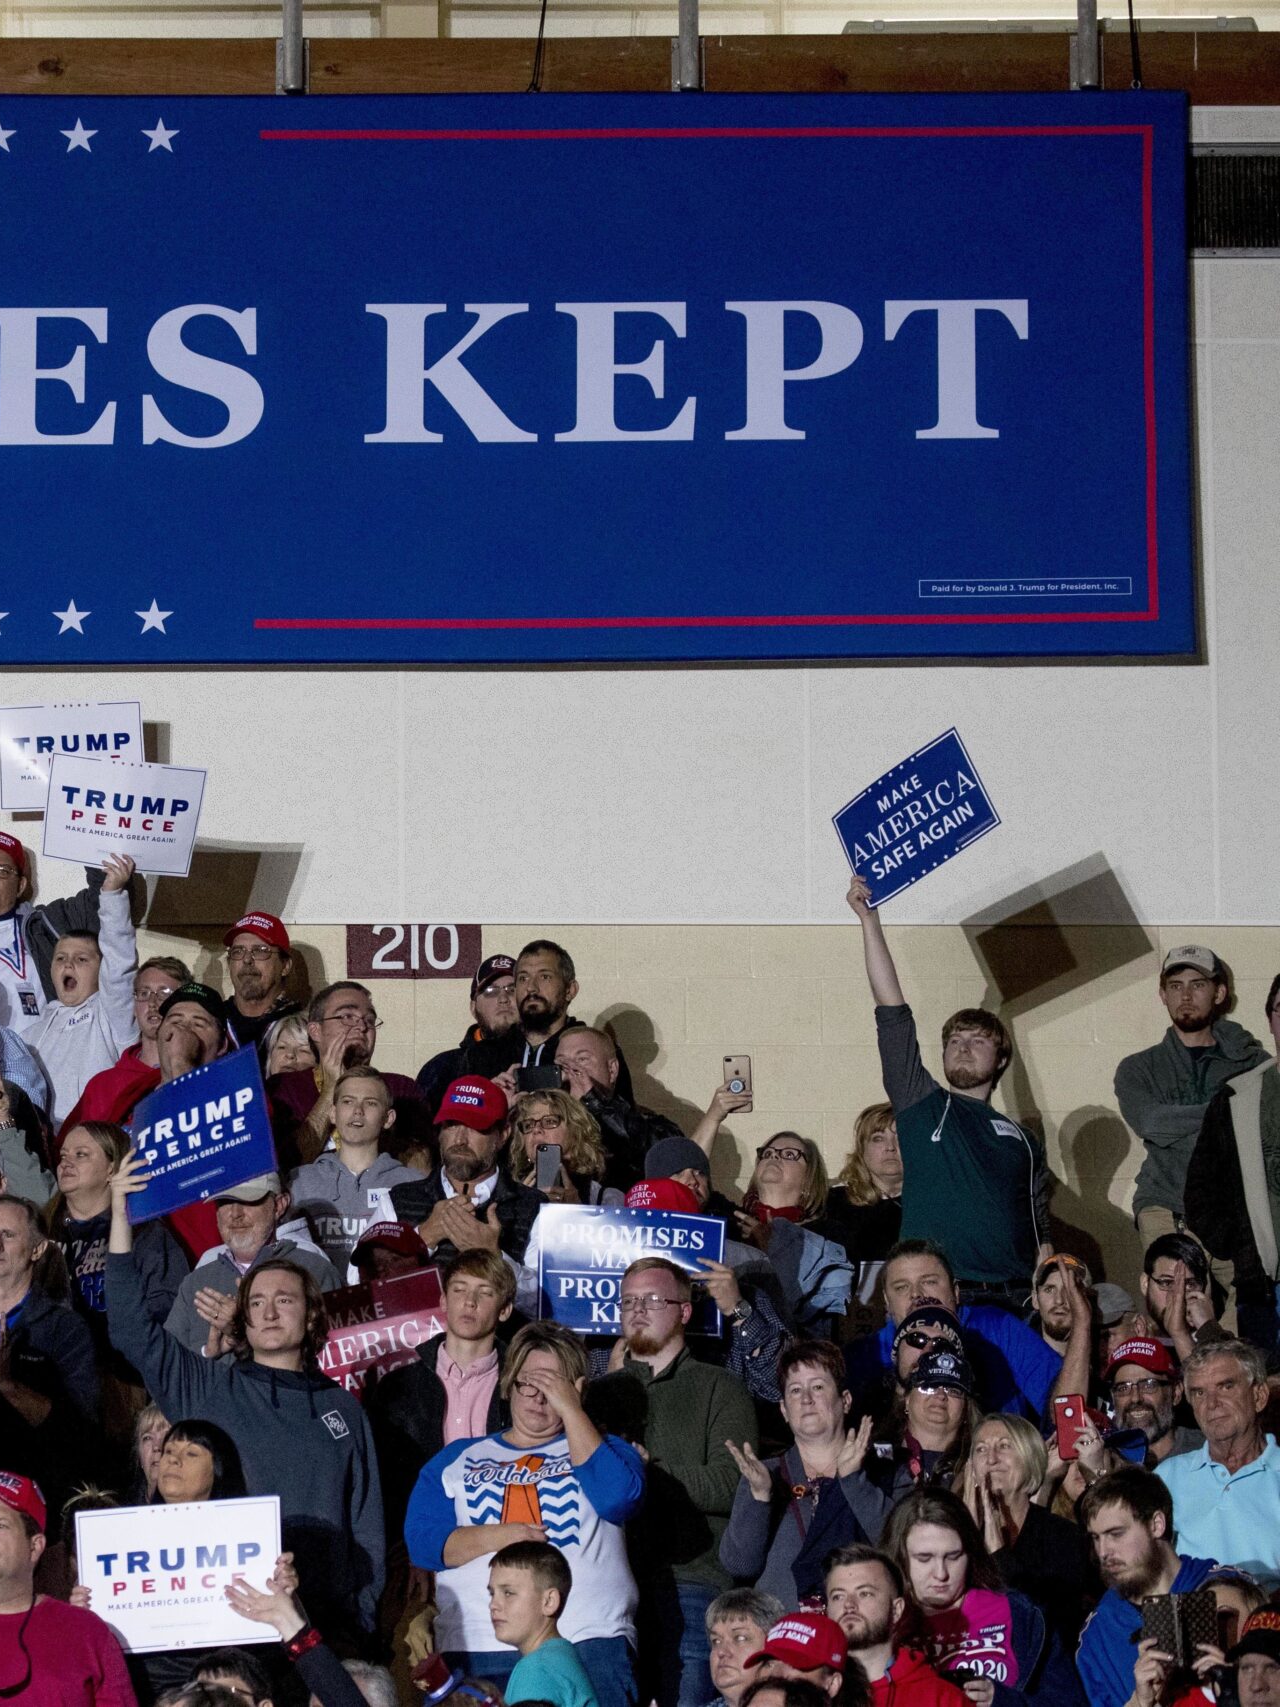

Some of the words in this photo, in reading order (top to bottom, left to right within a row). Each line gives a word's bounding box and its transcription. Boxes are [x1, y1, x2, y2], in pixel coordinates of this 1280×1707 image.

[364, 299, 1029, 443] KEPT
[952, 584, 964, 592] for
[965, 585, 976, 593] by
[977, 584, 1007, 592] Donald
[1017, 584, 1045, 592] Trump
[1047, 583, 1059, 591] for
[61, 785, 189, 817] TRUMP
[876, 774, 922, 813] MAKE
[71, 809, 175, 833] PENCE
[853, 770, 976, 868] AMERICA
[65, 824, 87, 834] MAKE
[89, 830, 124, 840] AMERICA
[126, 834, 149, 842] GREAT
[151, 836, 177, 844] AGAIN!
[871, 839, 917, 880] SAFE
[918, 801, 974, 850] AGAIN
[372, 924, 459, 970] 210
[454, 1095, 479, 1106] 2020
[455, 1085, 486, 1095] TRUMP
[137, 1087, 253, 1150] TRUMP
[145, 1117, 246, 1166] PENCE
[166, 1154, 199, 1172] AMERICA
[199, 1145, 224, 1159] GREAT
[224, 1133, 252, 1150] AGAIN!
[200, 1189, 210, 1199] 45
[562, 1223, 705, 1250] PROMISES
[327, 1301, 387, 1331] MAKE
[316, 1314, 444, 1371] MERICA
[1127, 1341, 1157, 1352] AMERICA
[1131, 1347, 1154, 1357] AGAIN
[96, 1541, 261, 1577] TRUMP
[107, 1603, 134, 1611] MAKE
[136, 1598, 180, 1609] AMERICA
[183, 1594, 215, 1605] GREAT
[782, 1620, 816, 1639] AMERICA
[785, 1630, 810, 1645] AGAIN
[980, 1624, 1006, 1634] TRUMP
[174, 1640, 186, 1648] 45
